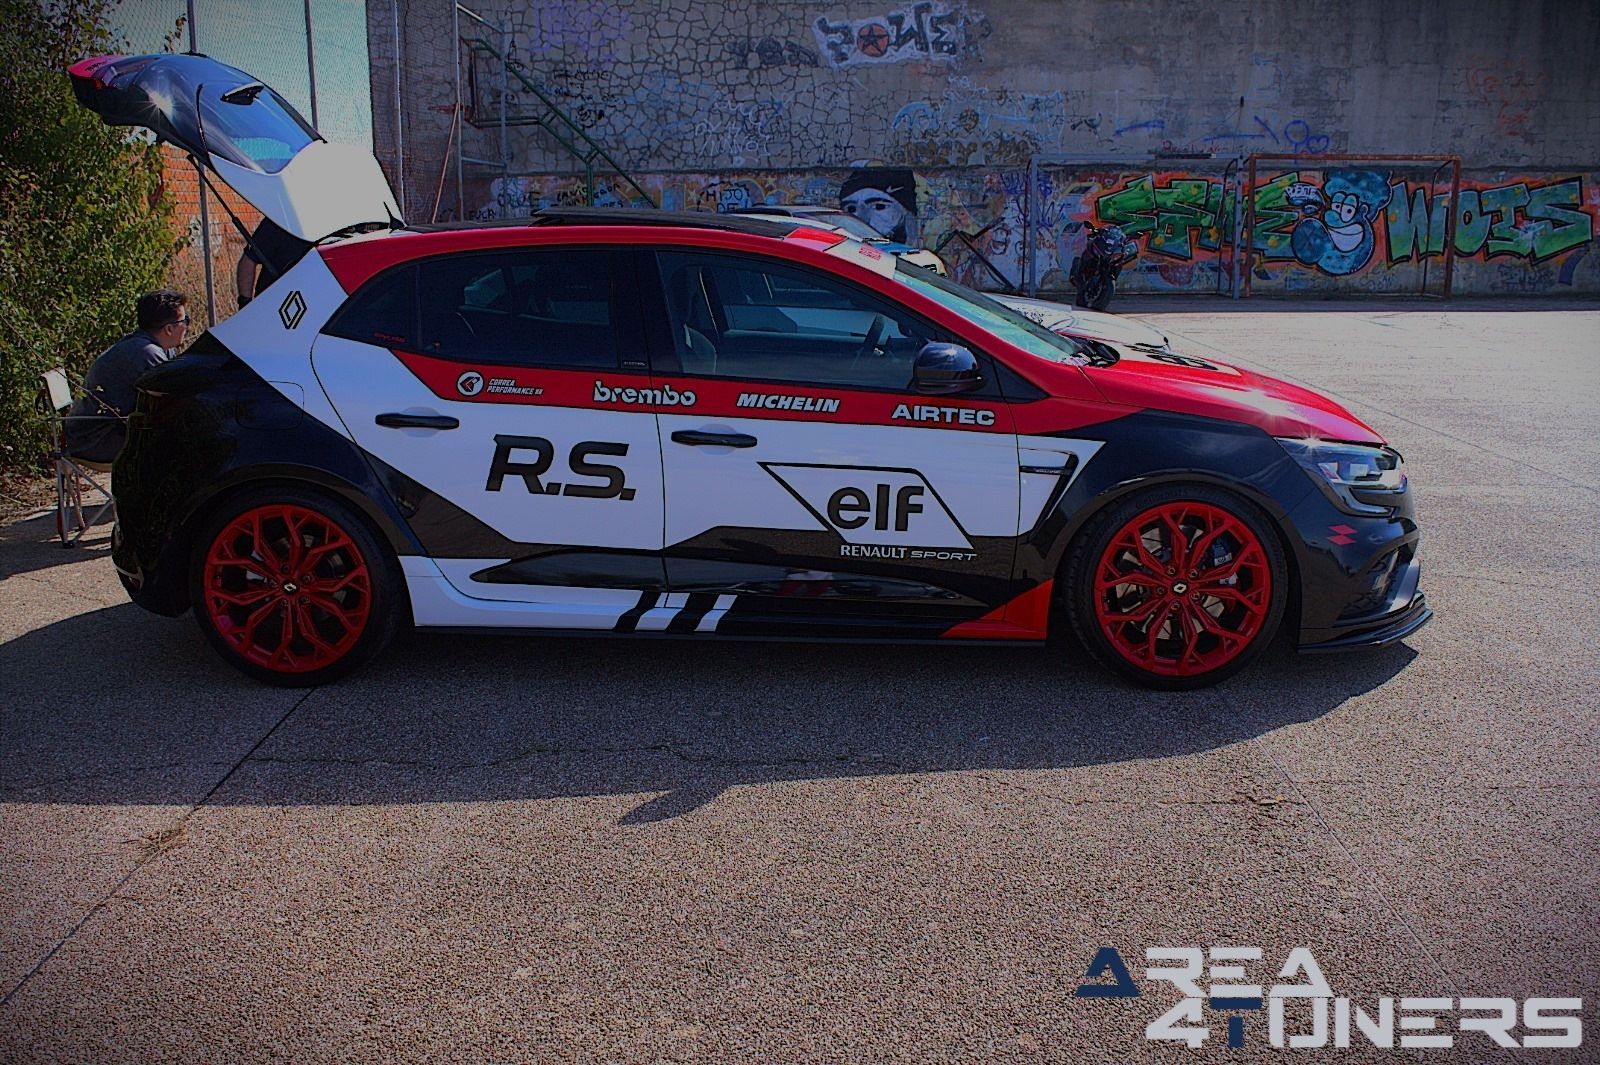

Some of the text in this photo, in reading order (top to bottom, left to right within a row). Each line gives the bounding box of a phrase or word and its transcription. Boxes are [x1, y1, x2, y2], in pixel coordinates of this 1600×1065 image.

[487, 386, 533, 395] PERFORMANCE
[489, 378, 515, 387] CORREA
[593, 380, 696, 406] brembo
[736, 393, 841, 413] MICHELIN
[891, 404, 995, 426] AIRTEC
[485, 434, 636, 501] R.S.
[827, 484, 924, 531] elf
[840, 544, 978, 561] RENAULT SPORT
